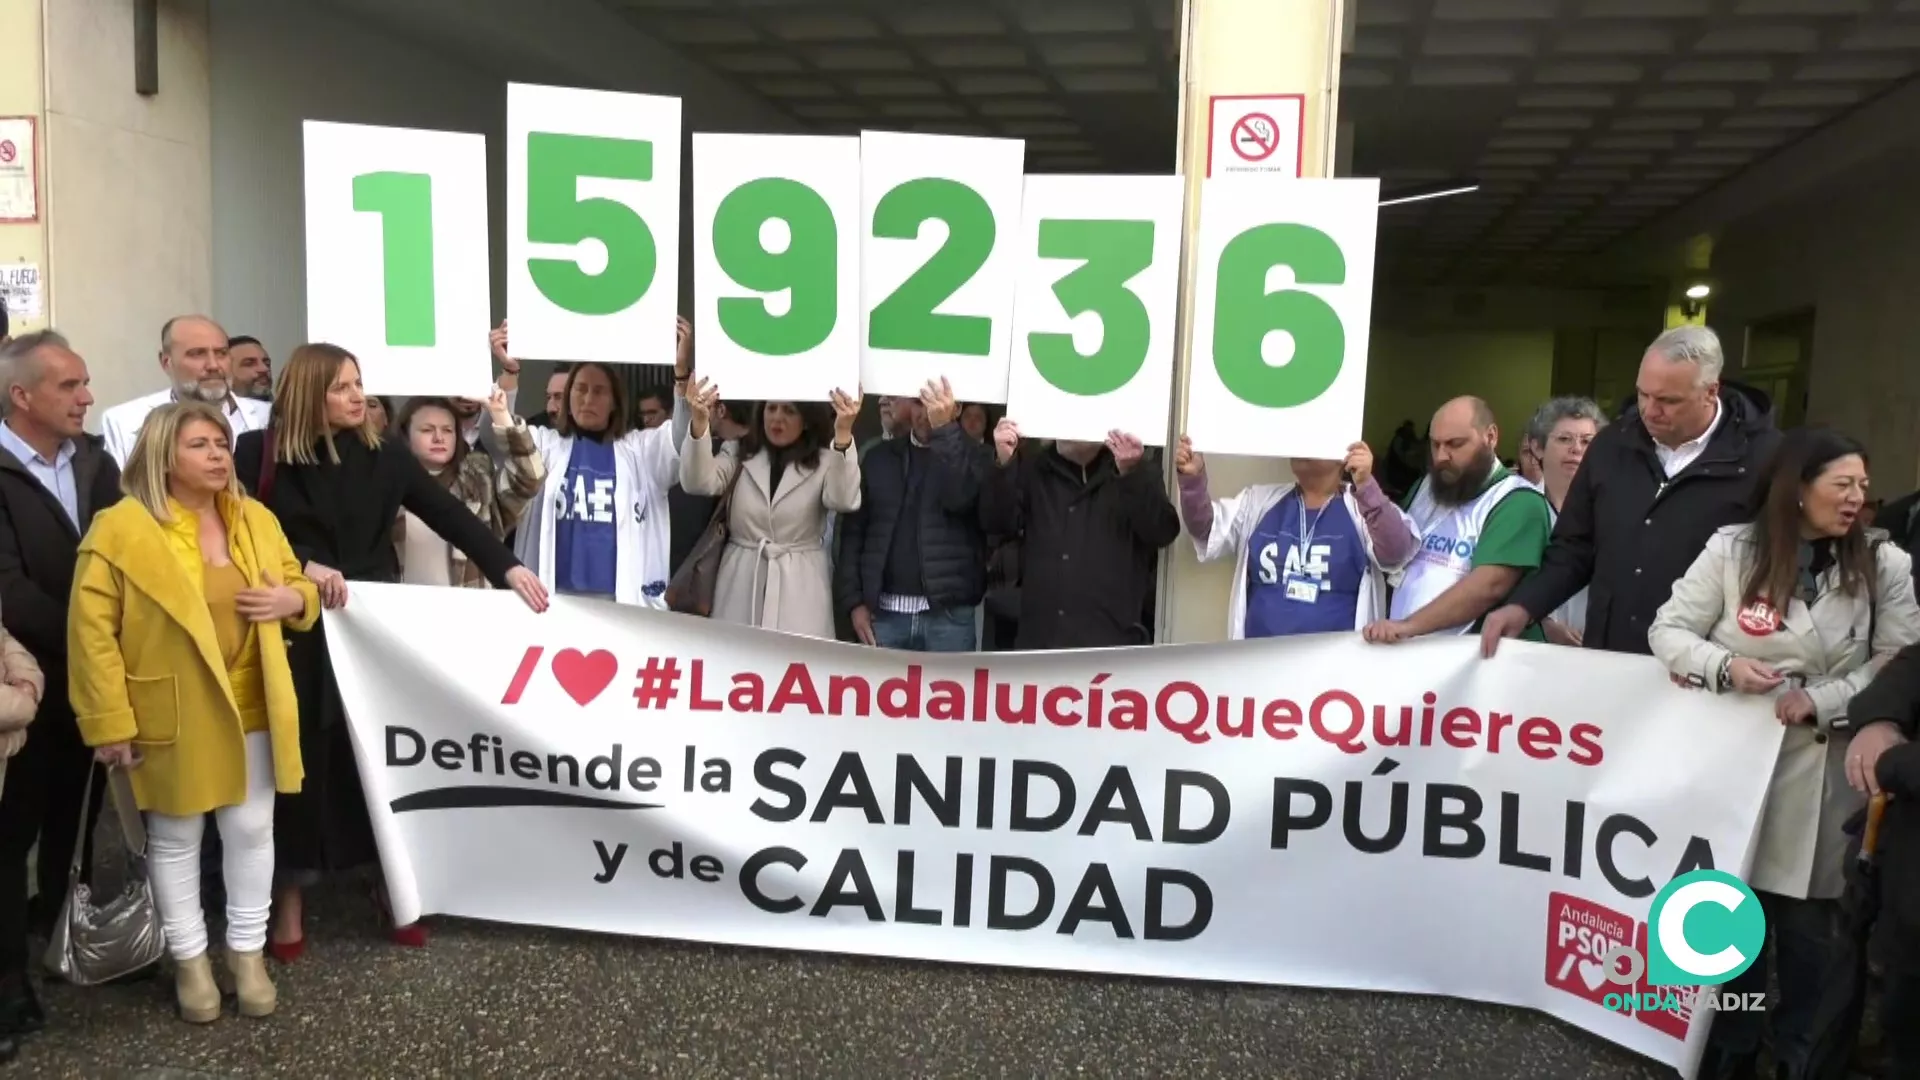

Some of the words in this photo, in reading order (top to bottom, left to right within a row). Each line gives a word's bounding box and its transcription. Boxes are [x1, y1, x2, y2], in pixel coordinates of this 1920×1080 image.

[353, 171, 436, 347] 1
[527, 131, 657, 315] 5
[713, 177, 838, 356] 9
[868, 177, 996, 356] 2
[1028, 218, 1155, 396] 3
[1212, 222, 1346, 408] 6
[385, 725, 663, 791] Defiende
[683, 745, 732, 793] la
[749, 747, 1231, 844] SANIDAD
[633, 657, 1604, 766] #LaAndalucíaQueQuieres
[592, 839, 629, 884] y
[648, 840, 725, 883] de
[738, 845, 1215, 942] CALIDAD
[1560, 904, 1624, 940] Andalucía
